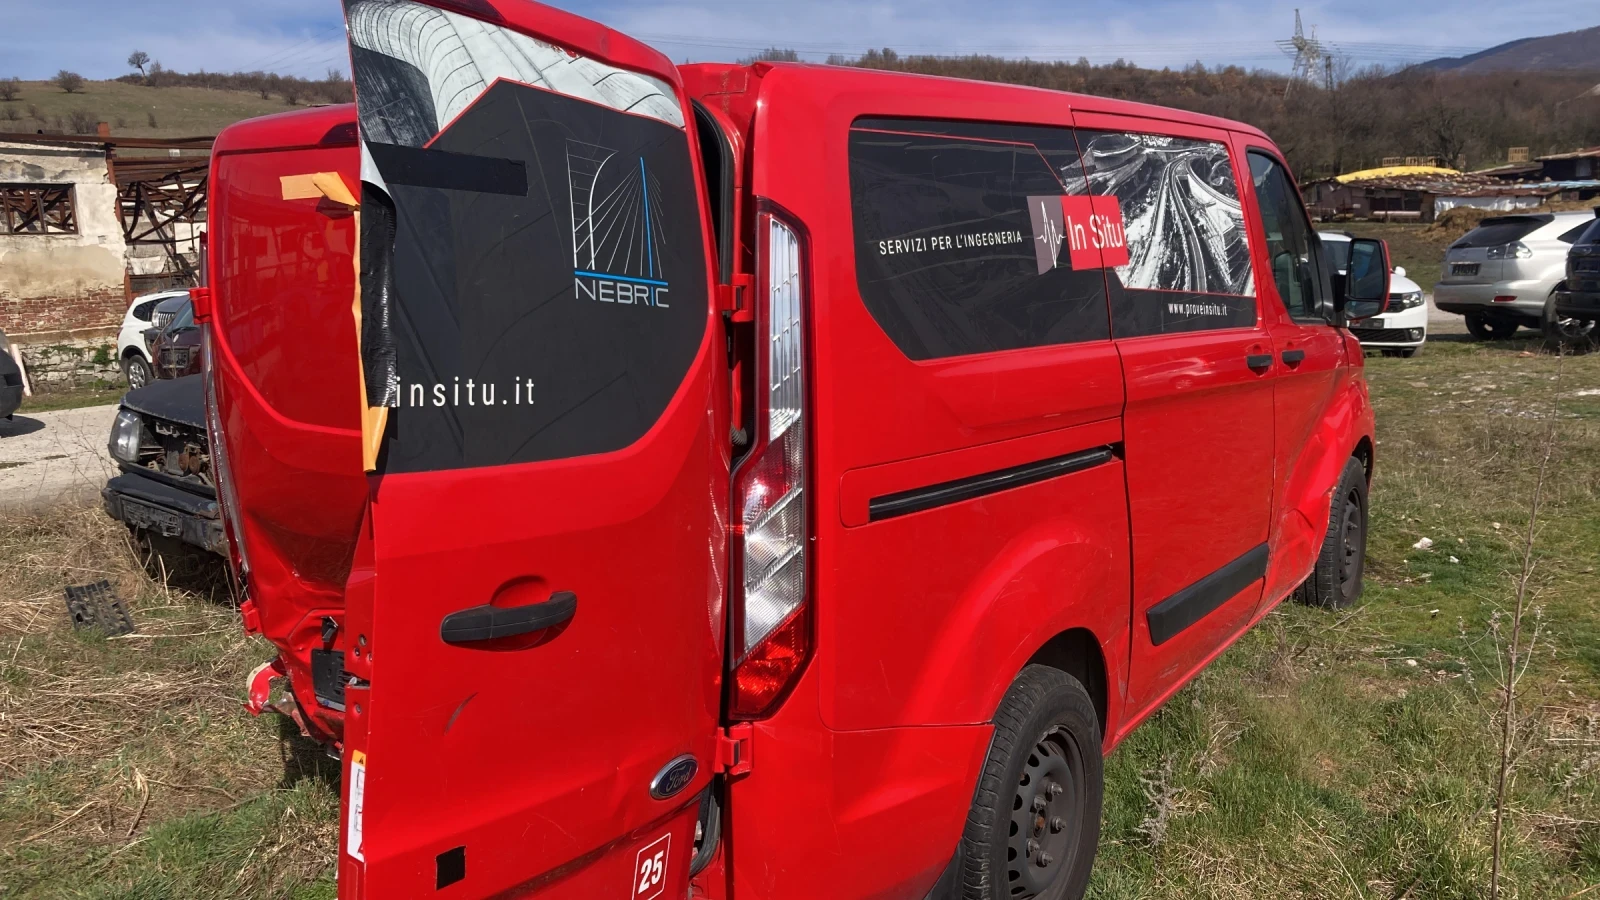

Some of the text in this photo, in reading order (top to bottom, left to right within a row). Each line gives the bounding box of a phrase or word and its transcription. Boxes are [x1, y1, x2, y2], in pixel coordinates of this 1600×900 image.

[879, 230, 1023, 255] SERVIZI PER L'INGEGNERIA
[1067, 214, 1124, 250] In Situ
[575, 278, 670, 308] NEBRIC
[1168, 302, 1228, 318] www.proveinsitu.it
[666, 763, 693, 793] Ford
[638, 850, 664, 894] 25
